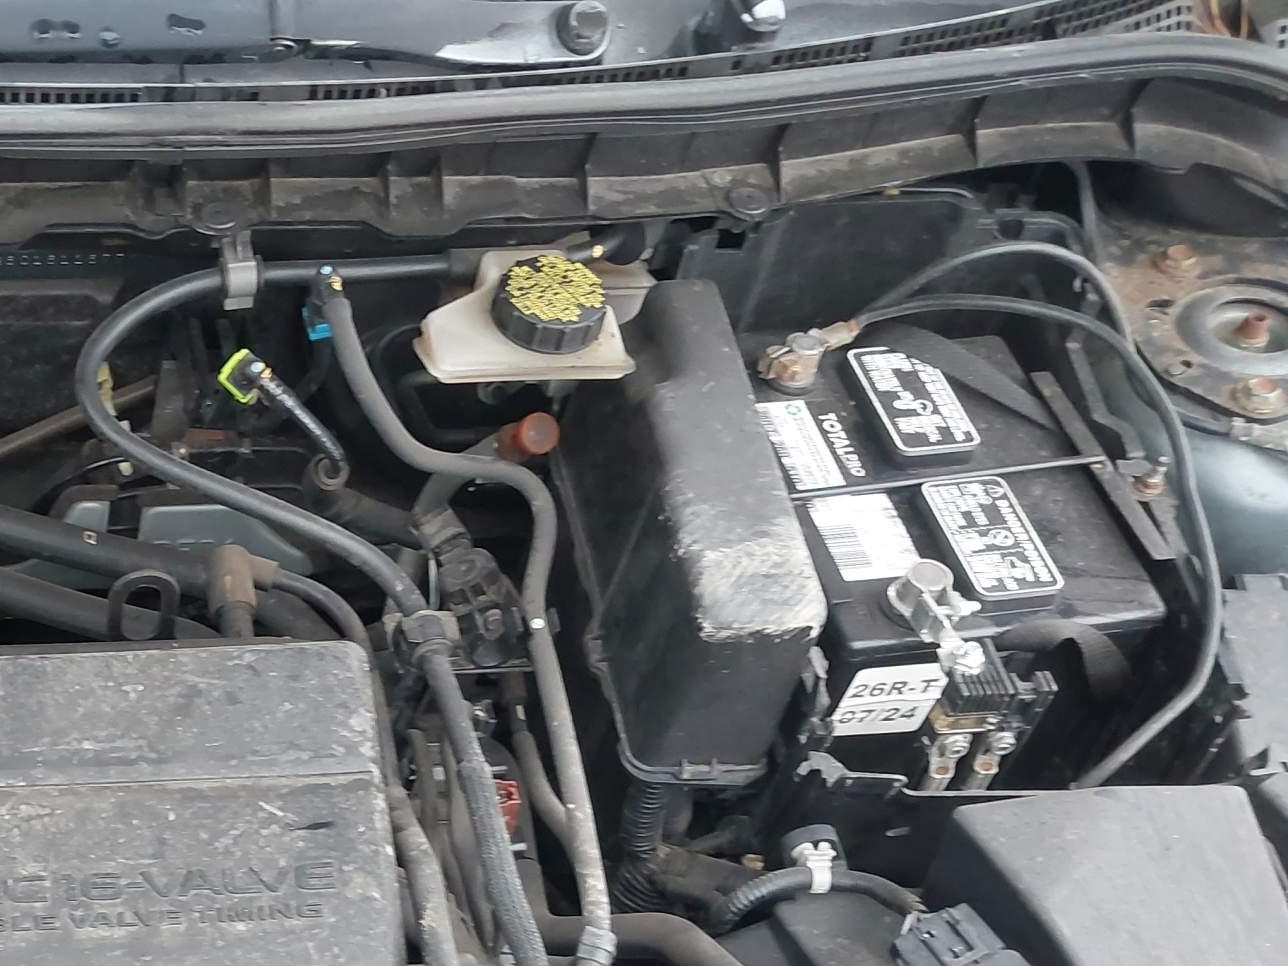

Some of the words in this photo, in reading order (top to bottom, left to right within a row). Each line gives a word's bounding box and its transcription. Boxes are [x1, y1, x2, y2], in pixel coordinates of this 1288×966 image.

[817, 412, 866, 477] TOTALPRO
[67, 908, 184, 930] VALVE
[197, 902, 324, 924] TIMING
